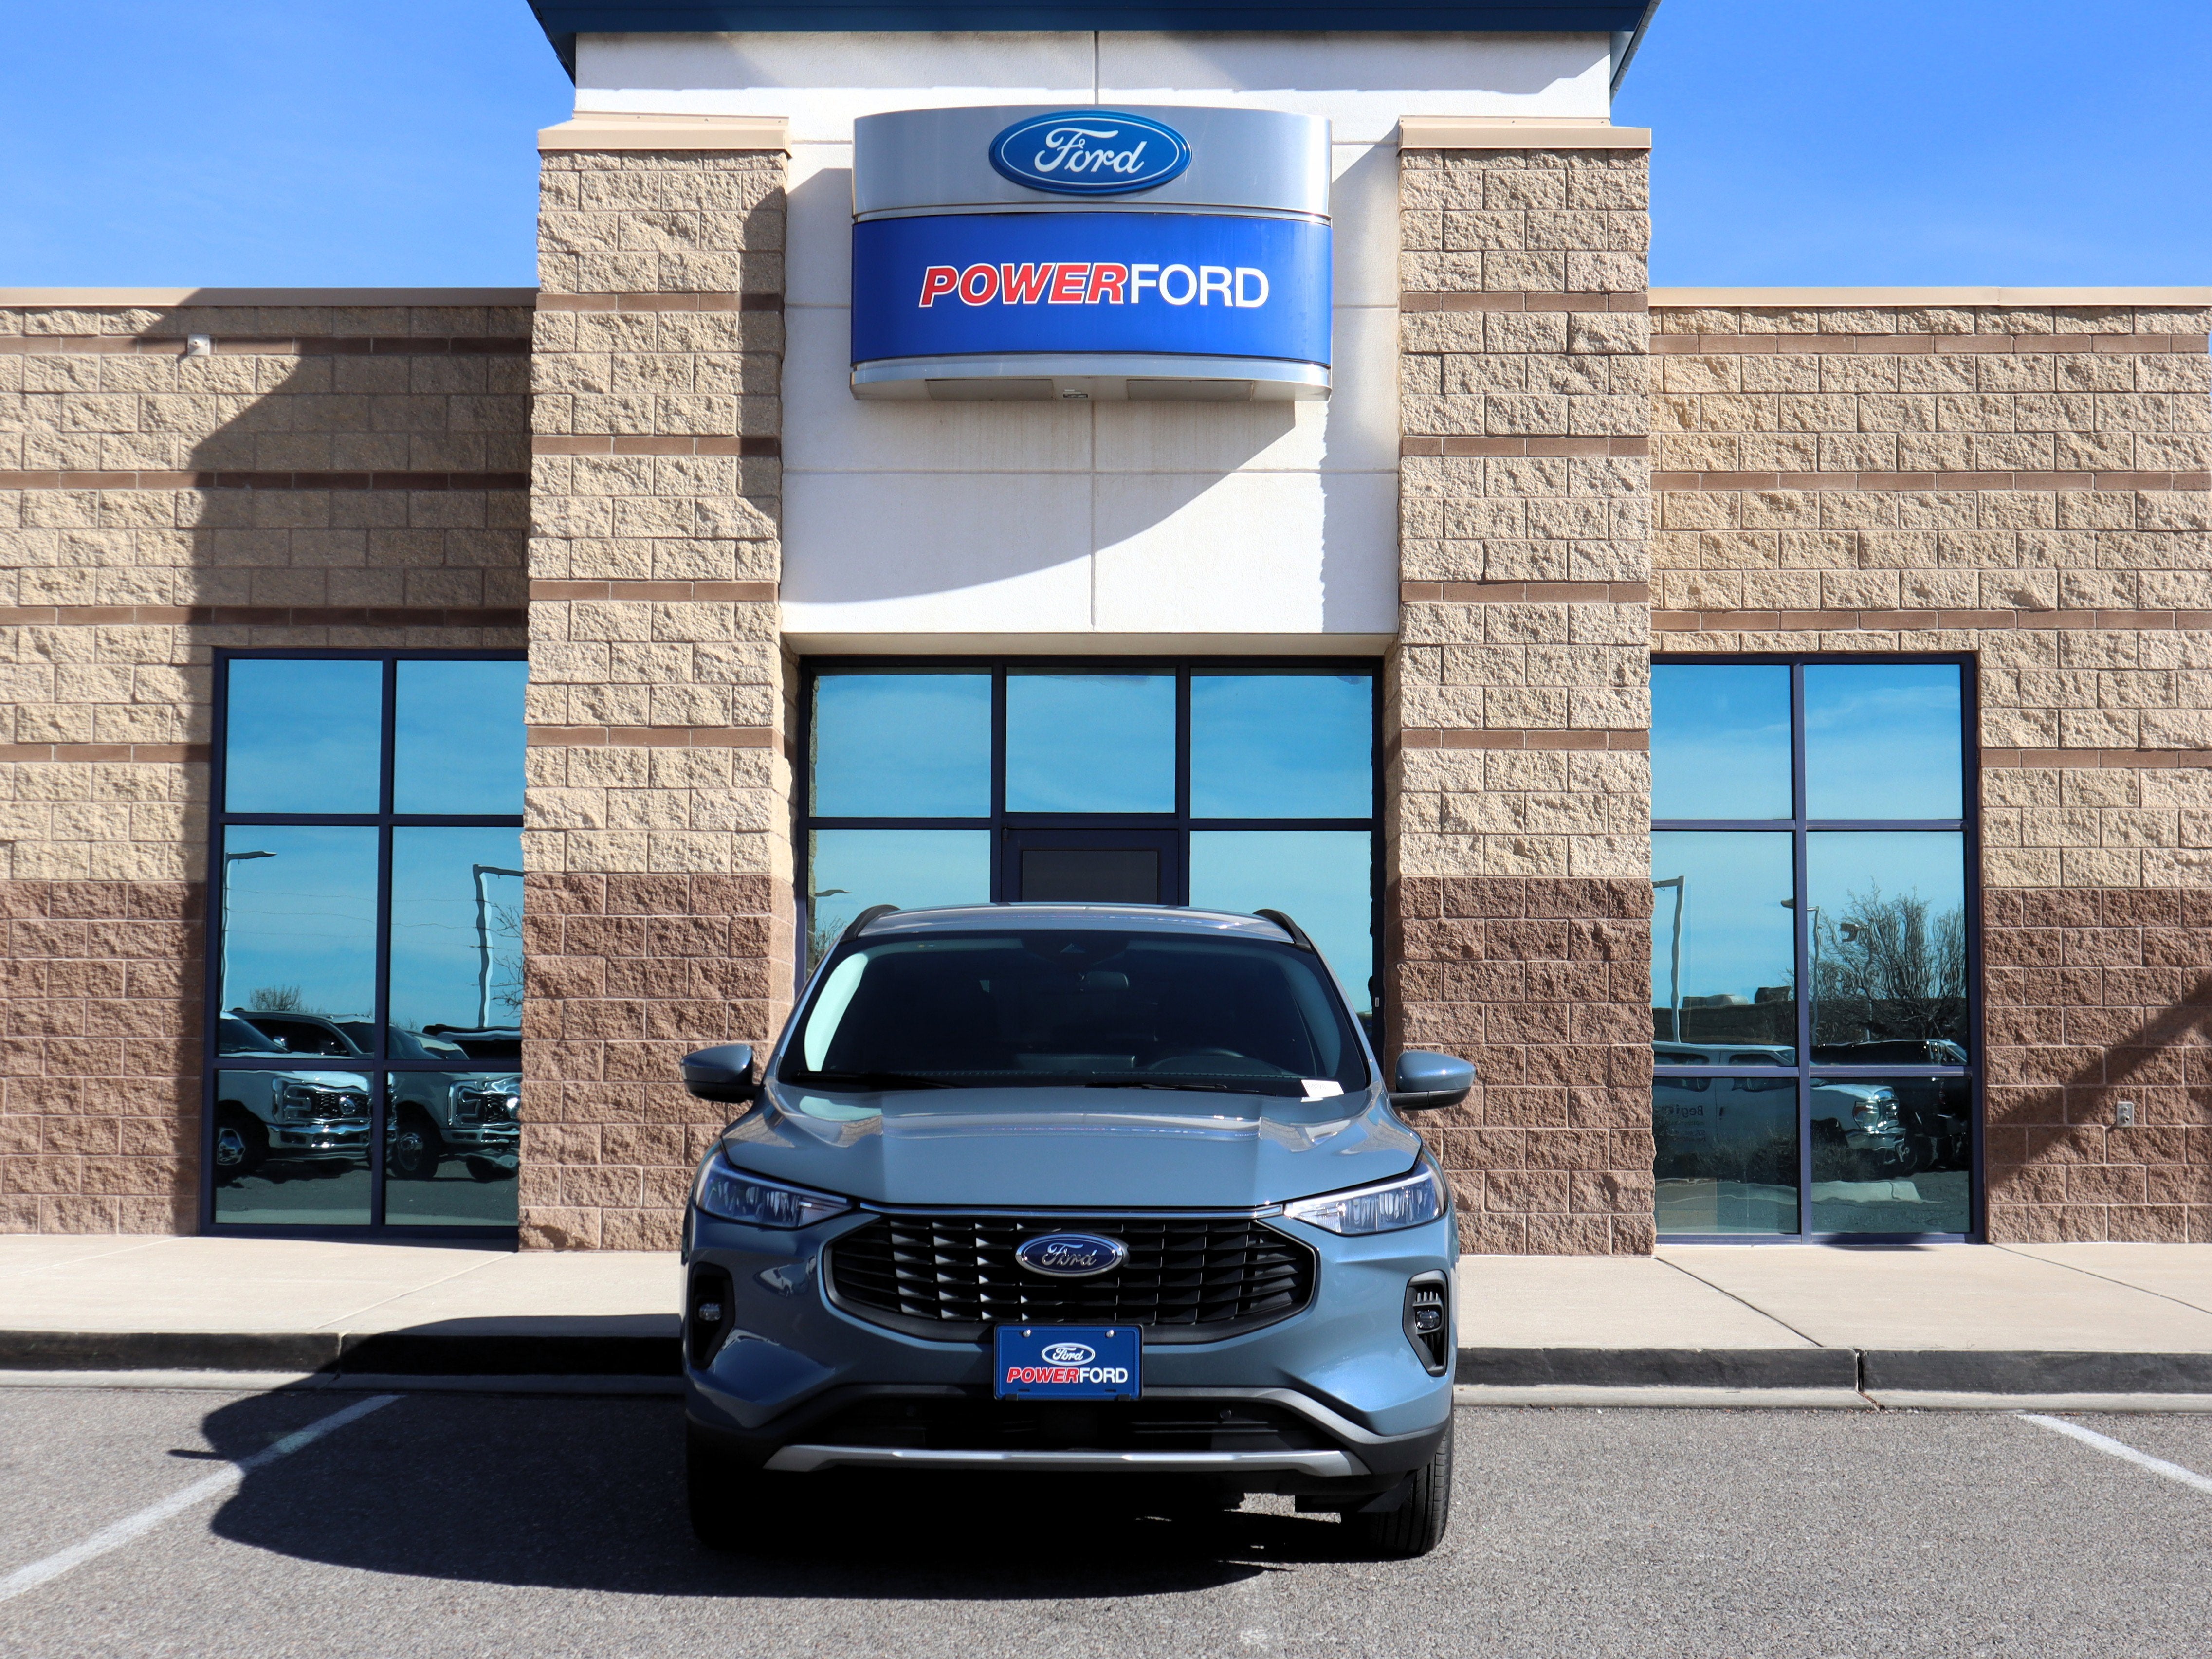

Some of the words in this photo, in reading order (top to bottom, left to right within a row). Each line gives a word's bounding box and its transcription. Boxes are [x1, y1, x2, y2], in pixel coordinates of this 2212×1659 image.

[1034, 127, 1148, 173] Ford
[1042, 1242, 1097, 1266] Ford
[1052, 1347, 1084, 1361] Ford
